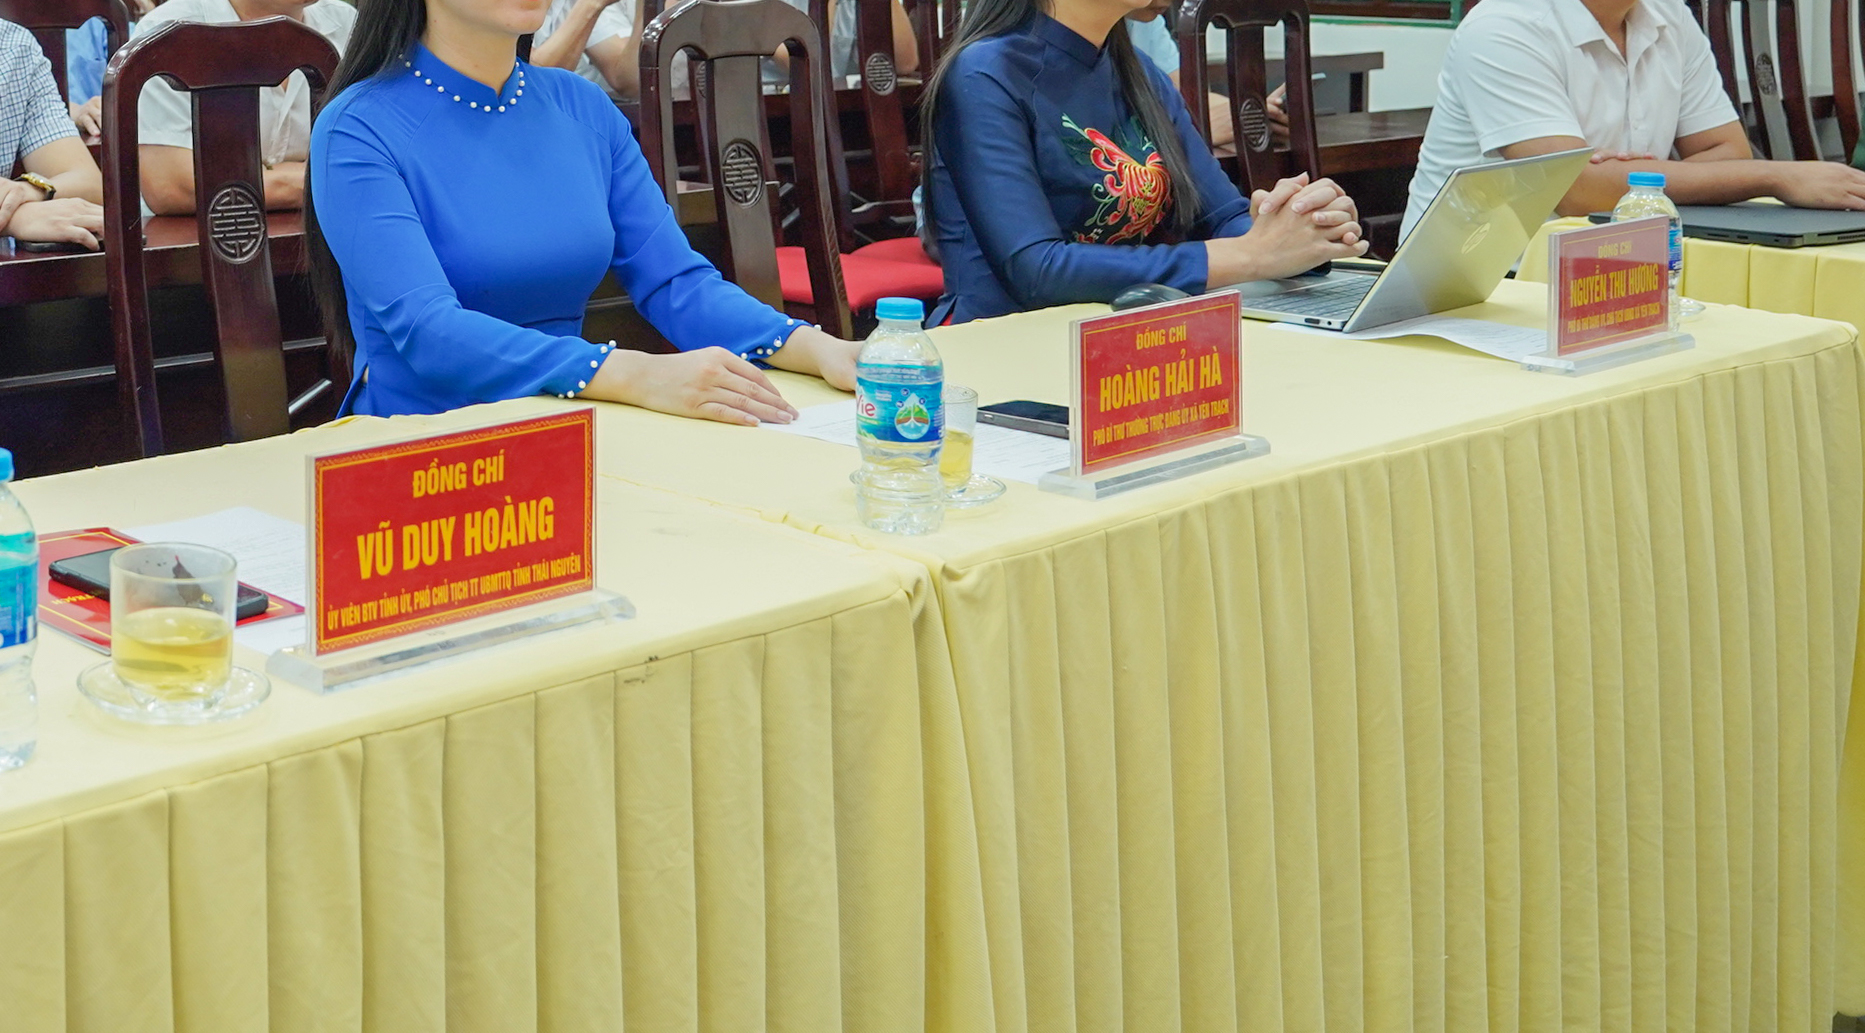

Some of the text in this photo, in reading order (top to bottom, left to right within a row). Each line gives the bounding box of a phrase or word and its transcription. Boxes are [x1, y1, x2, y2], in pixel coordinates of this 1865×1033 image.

[1570, 265, 1607, 308] NGUYỄN
[1609, 270, 1626, 299] THU
[1136, 321, 1186, 350] ĐỒNG CHÍ
[1100, 346, 1222, 413] HOÀNG HẢI HÀ
[413, 449, 505, 498] ĐỒNG CHÍ
[357, 496, 554, 580] VŨ DUY HOÀNG
[341, 602, 361, 627] VIÊN
[362, 600, 378, 623] BTV
[414, 585, 431, 610] PHÓ
[432, 578, 449, 606] CHỦ
[450, 580, 469, 605] TỊCH
[469, 577, 479, 597] TT
[532, 558, 550, 582] THÁI
[550, 552, 581, 578] NGUYÊN
